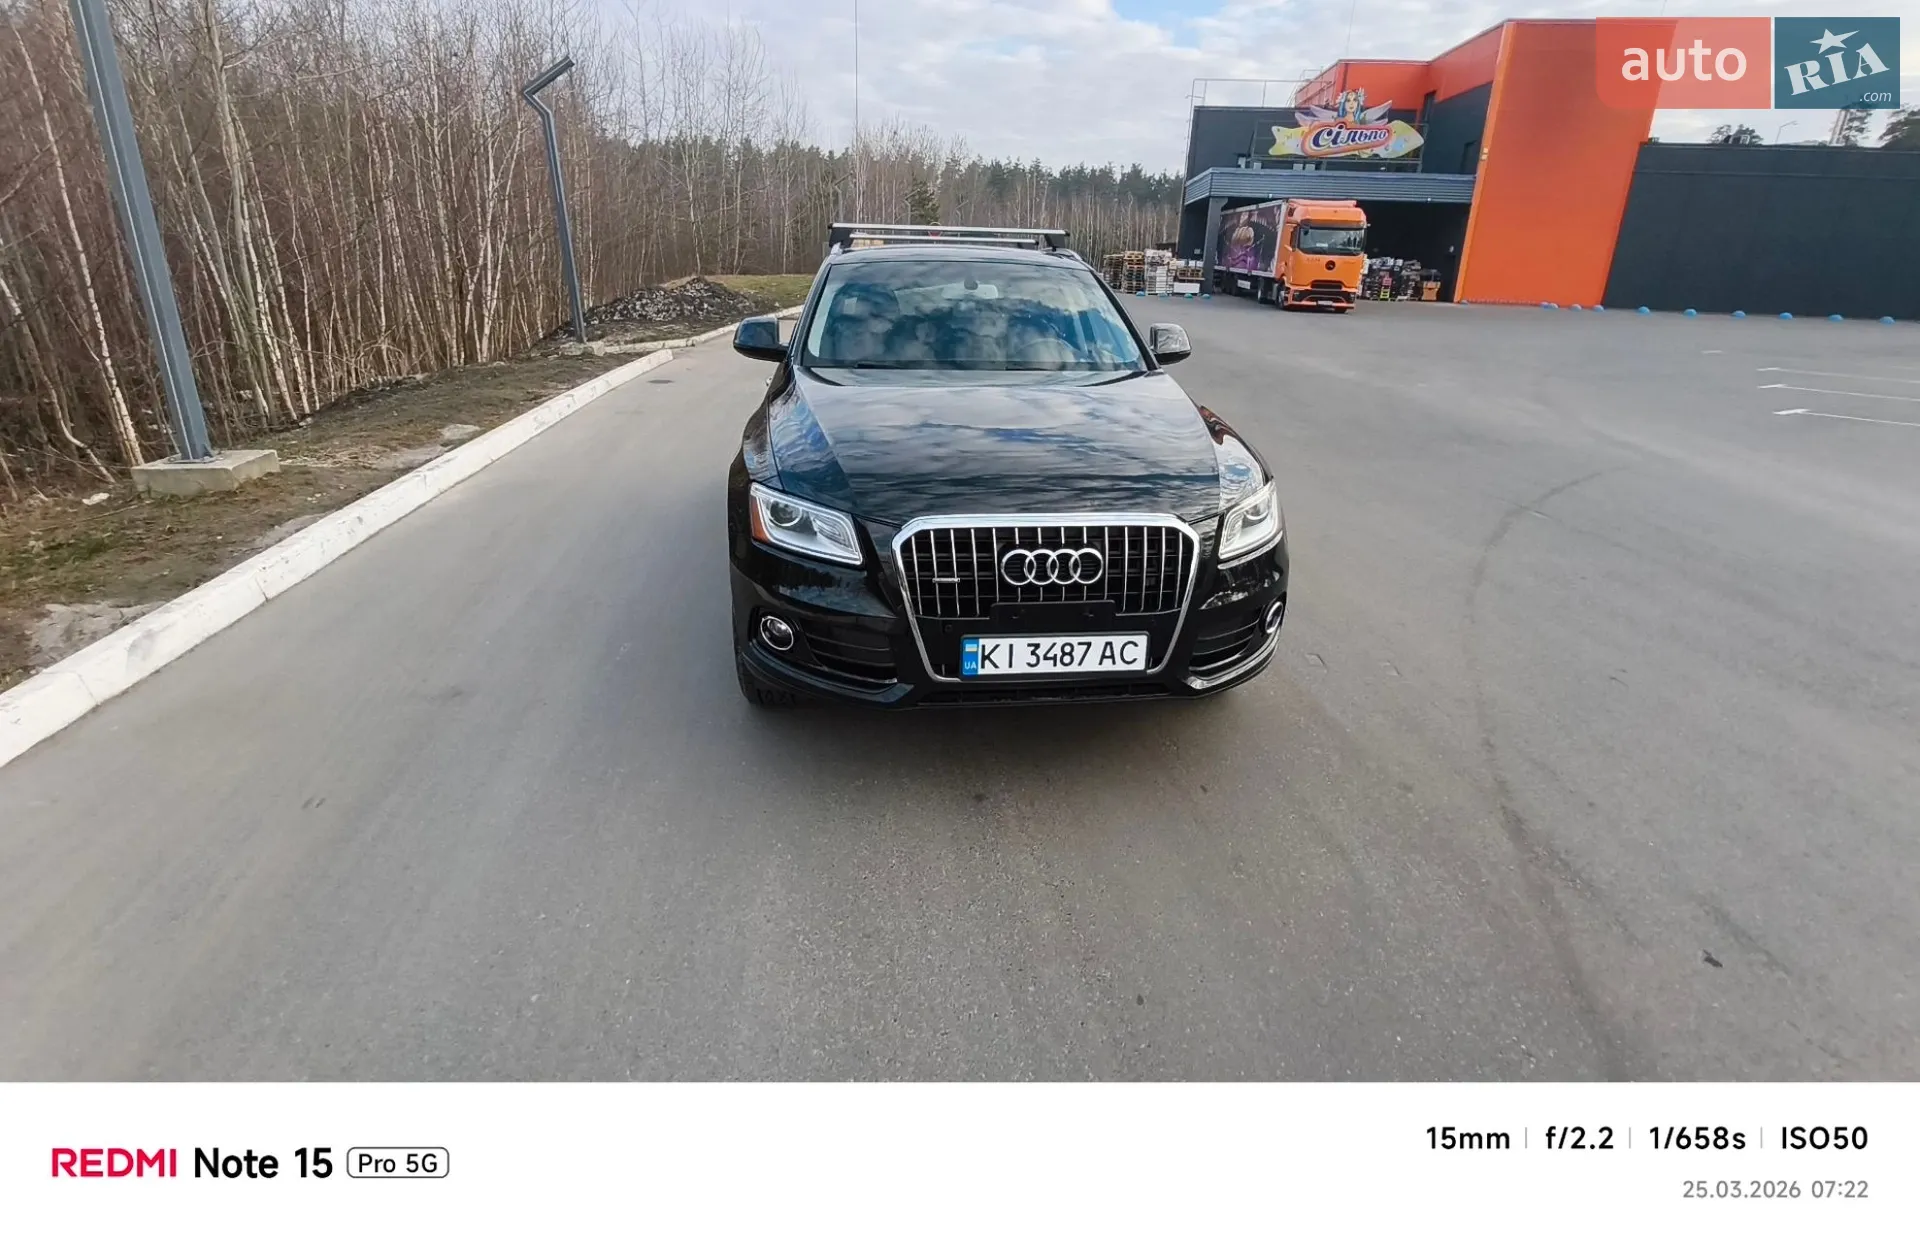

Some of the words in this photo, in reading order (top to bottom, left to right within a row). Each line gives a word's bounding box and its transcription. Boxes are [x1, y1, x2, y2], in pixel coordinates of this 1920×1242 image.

[1312, 123, 1388, 149] Сільпо
[964, 661, 977, 670] UA
[980, 643, 1014, 670] KI
[1025, 641, 1092, 668] 3487
[1098, 640, 1139, 666] AC
